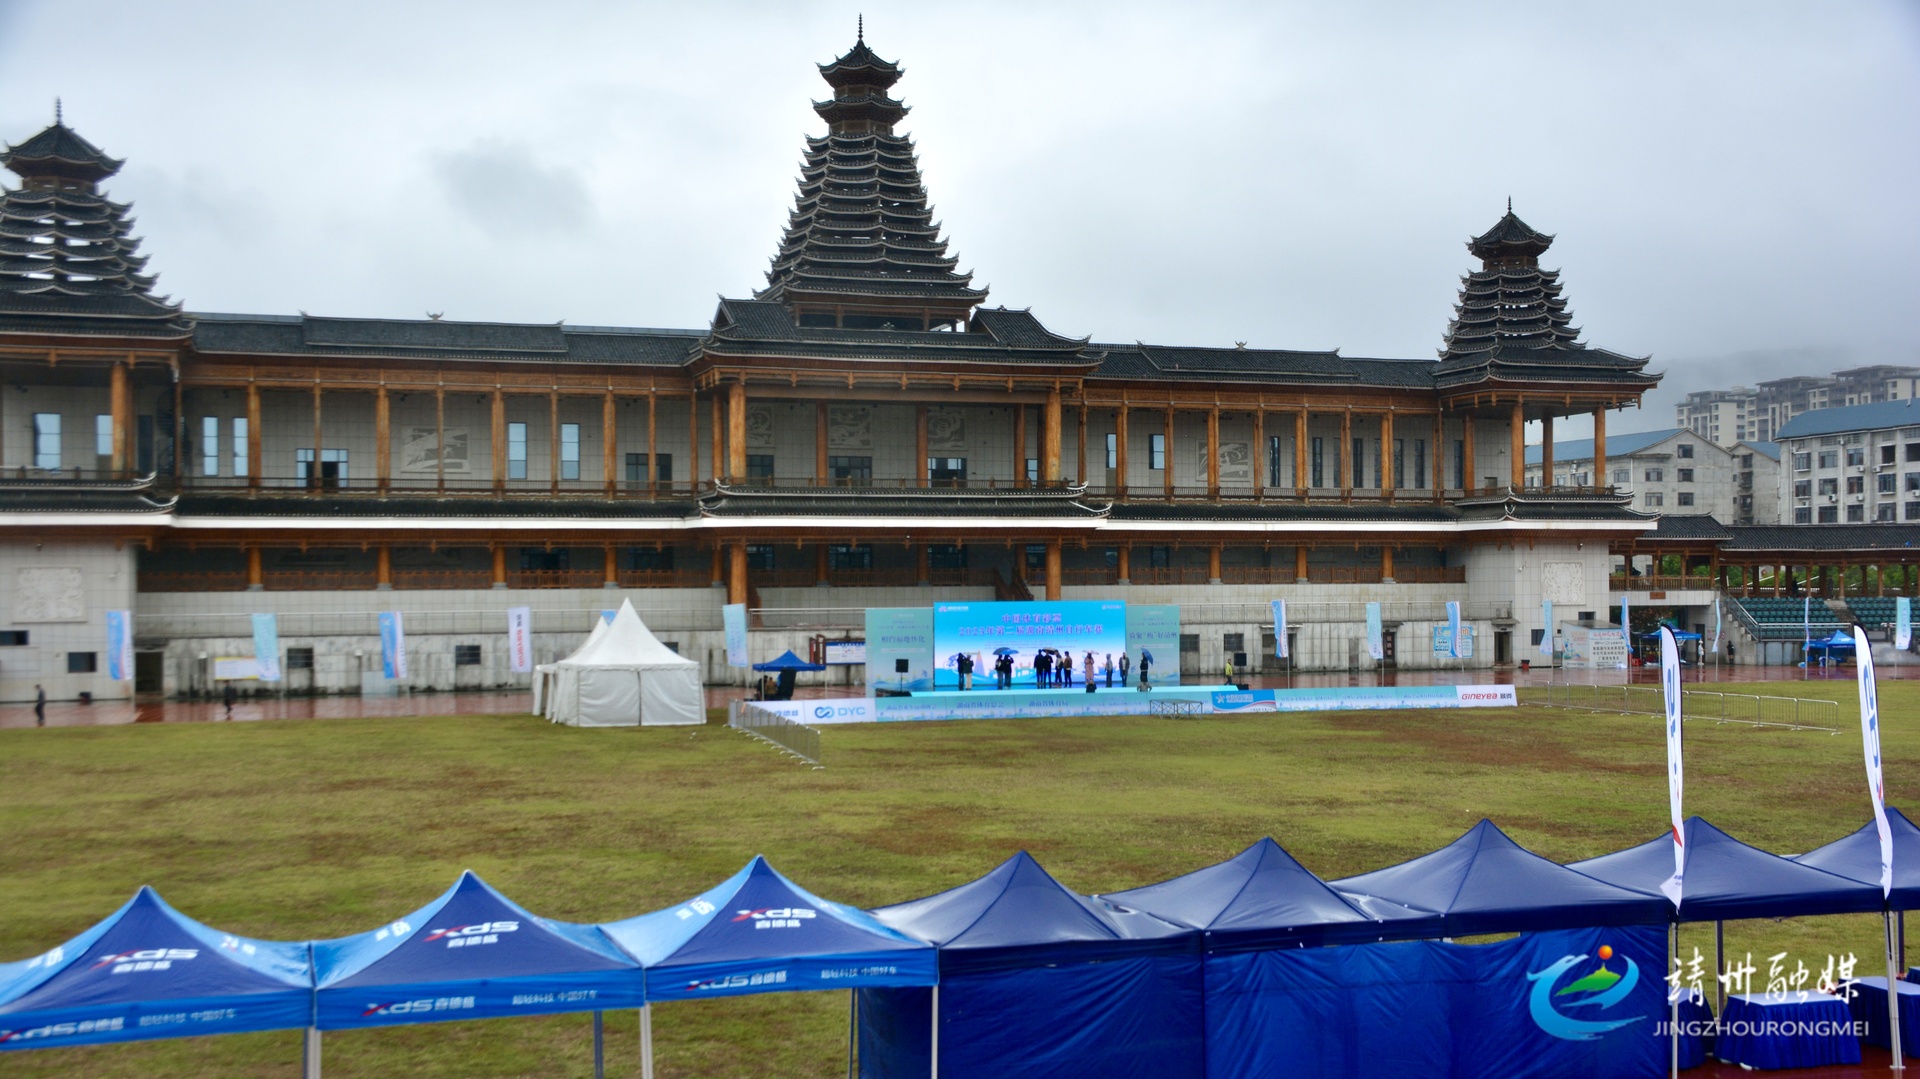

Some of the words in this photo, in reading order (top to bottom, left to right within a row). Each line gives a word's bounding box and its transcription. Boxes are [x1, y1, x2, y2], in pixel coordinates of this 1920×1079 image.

[1002, 613, 1062, 623] 中国体育彩票
[838, 706, 866, 716] DYC
[447, 933, 499, 948] 喜德盛
[821, 968, 859, 979] 超轻科技
[861, 965, 897, 976] 中国好车
[434, 996, 476, 1012] 喜德盛
[512, 993, 554, 1006] 超轻科技
[557, 989, 598, 1001] 中国好车
[190, 1008, 237, 1021] 中国好车
